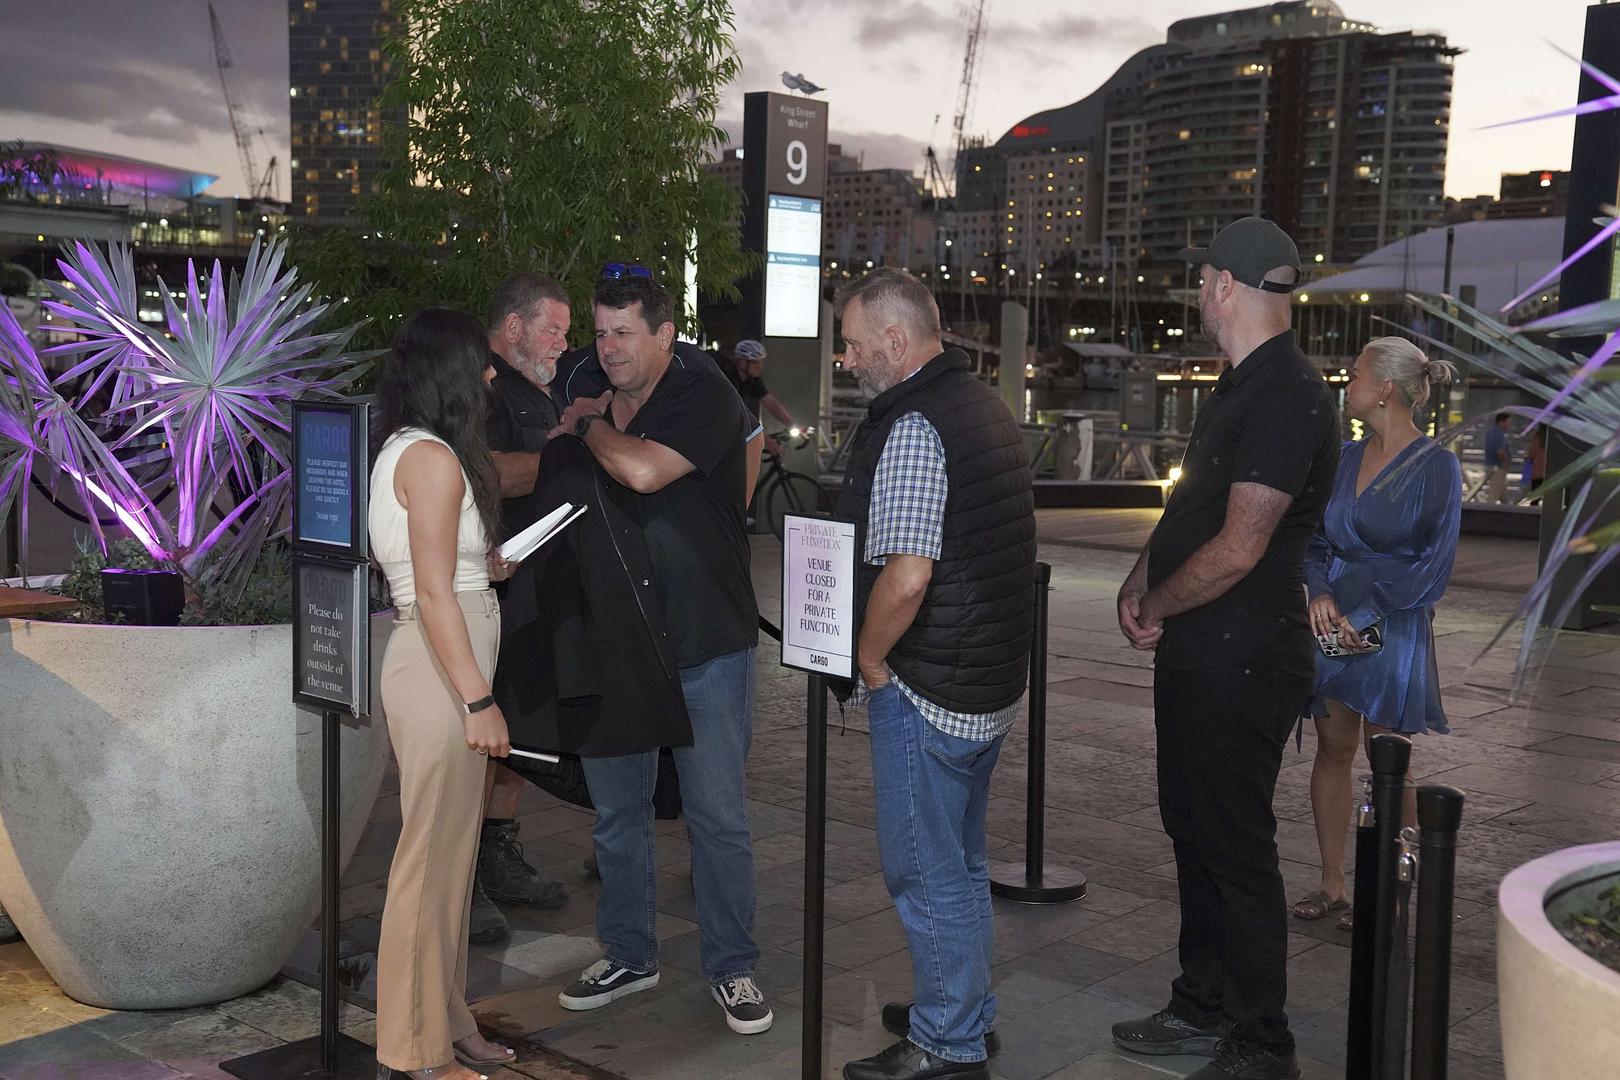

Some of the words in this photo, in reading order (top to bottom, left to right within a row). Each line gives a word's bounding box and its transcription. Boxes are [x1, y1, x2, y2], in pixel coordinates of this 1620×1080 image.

[780, 104, 795, 117] King
[796, 106, 816, 118] Street
[787, 118, 808, 129] Wharf
[786, 140, 807, 185] 9
[304, 424, 349, 453] CARGO
[306, 458, 321, 466] PLEASE
[305, 485, 321, 493] PLEASE
[804, 523, 838, 538] PRIVATE
[801, 535, 841, 551] FUNCTION
[807, 557, 832, 572] VENUE
[805, 572, 836, 588] CLOSED
[808, 588, 823, 601] FOR
[825, 591, 831, 603] A
[308, 603, 331, 619] Please
[332, 607, 343, 620] do
[804, 603, 837, 620] PRIVATE
[310, 624, 324, 635] not
[324, 626, 341, 638] take
[800, 618, 840, 636] FUNCTION
[313, 640, 338, 656] drinks
[307, 659, 335, 674] outside
[335, 663, 345, 675] of
[810, 653, 829, 667] CARGO
[307, 675, 321, 687] the
[321, 680, 344, 693] venue
